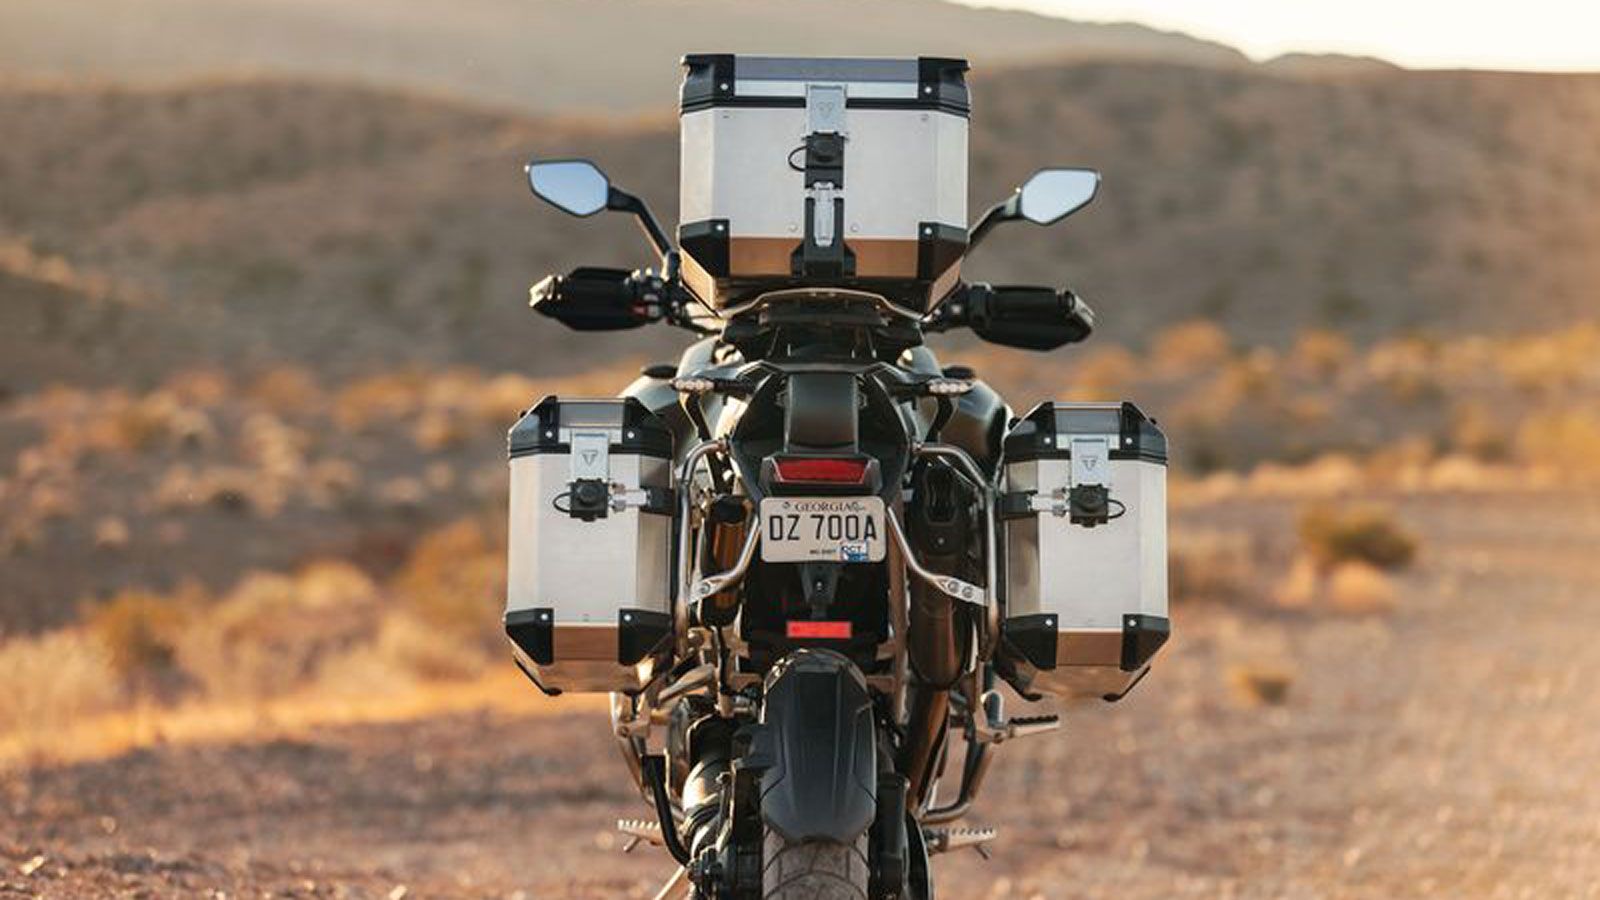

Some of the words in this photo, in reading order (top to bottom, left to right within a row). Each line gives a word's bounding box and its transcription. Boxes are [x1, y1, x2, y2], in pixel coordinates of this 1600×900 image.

[794, 501, 851, 511] GEORGIA
[769, 515, 800, 540] DZ
[810, 515, 877, 540] 700A
